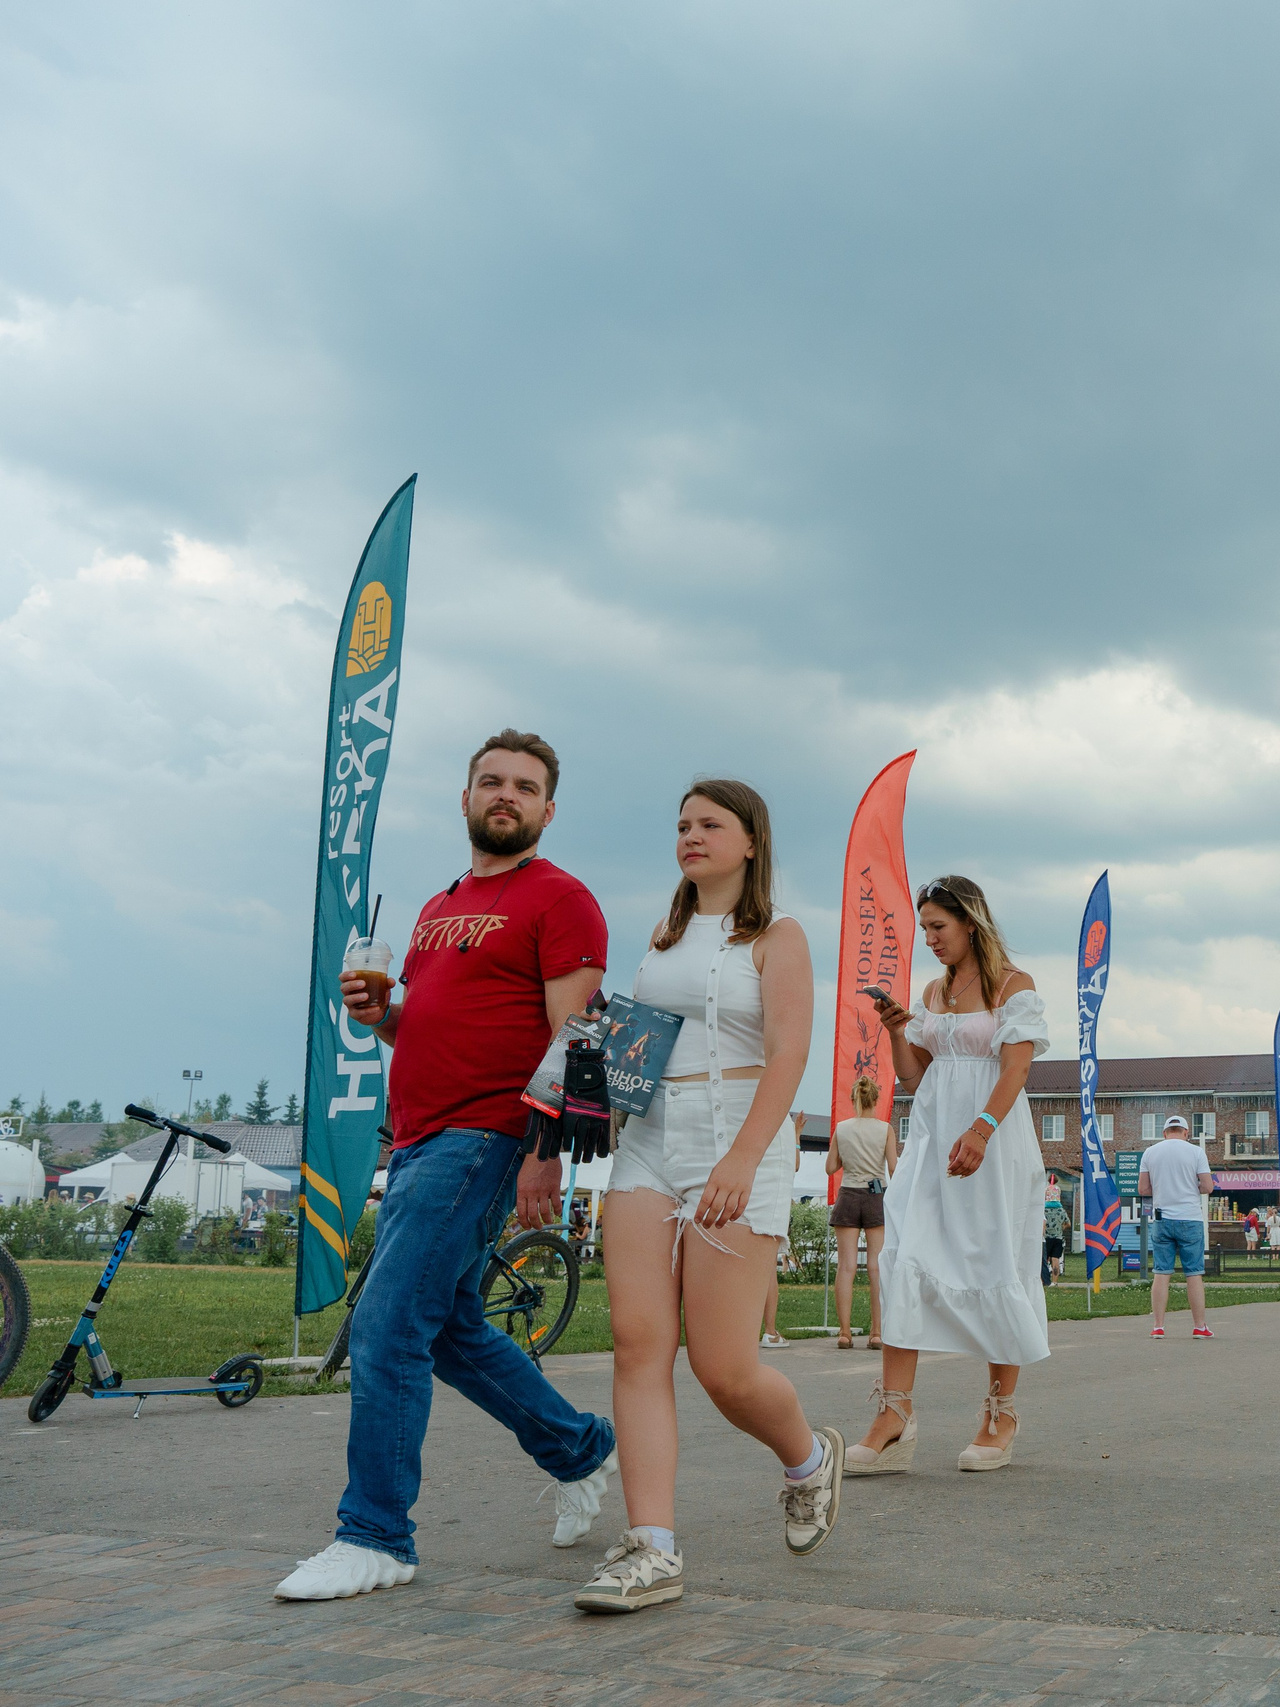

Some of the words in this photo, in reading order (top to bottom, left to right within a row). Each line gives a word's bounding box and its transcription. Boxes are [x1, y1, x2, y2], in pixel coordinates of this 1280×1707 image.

[327, 702, 352, 860] resort
[856, 866, 876, 996] HORSEKA
[1221, 1172, 1274, 1182] IVANOVO
